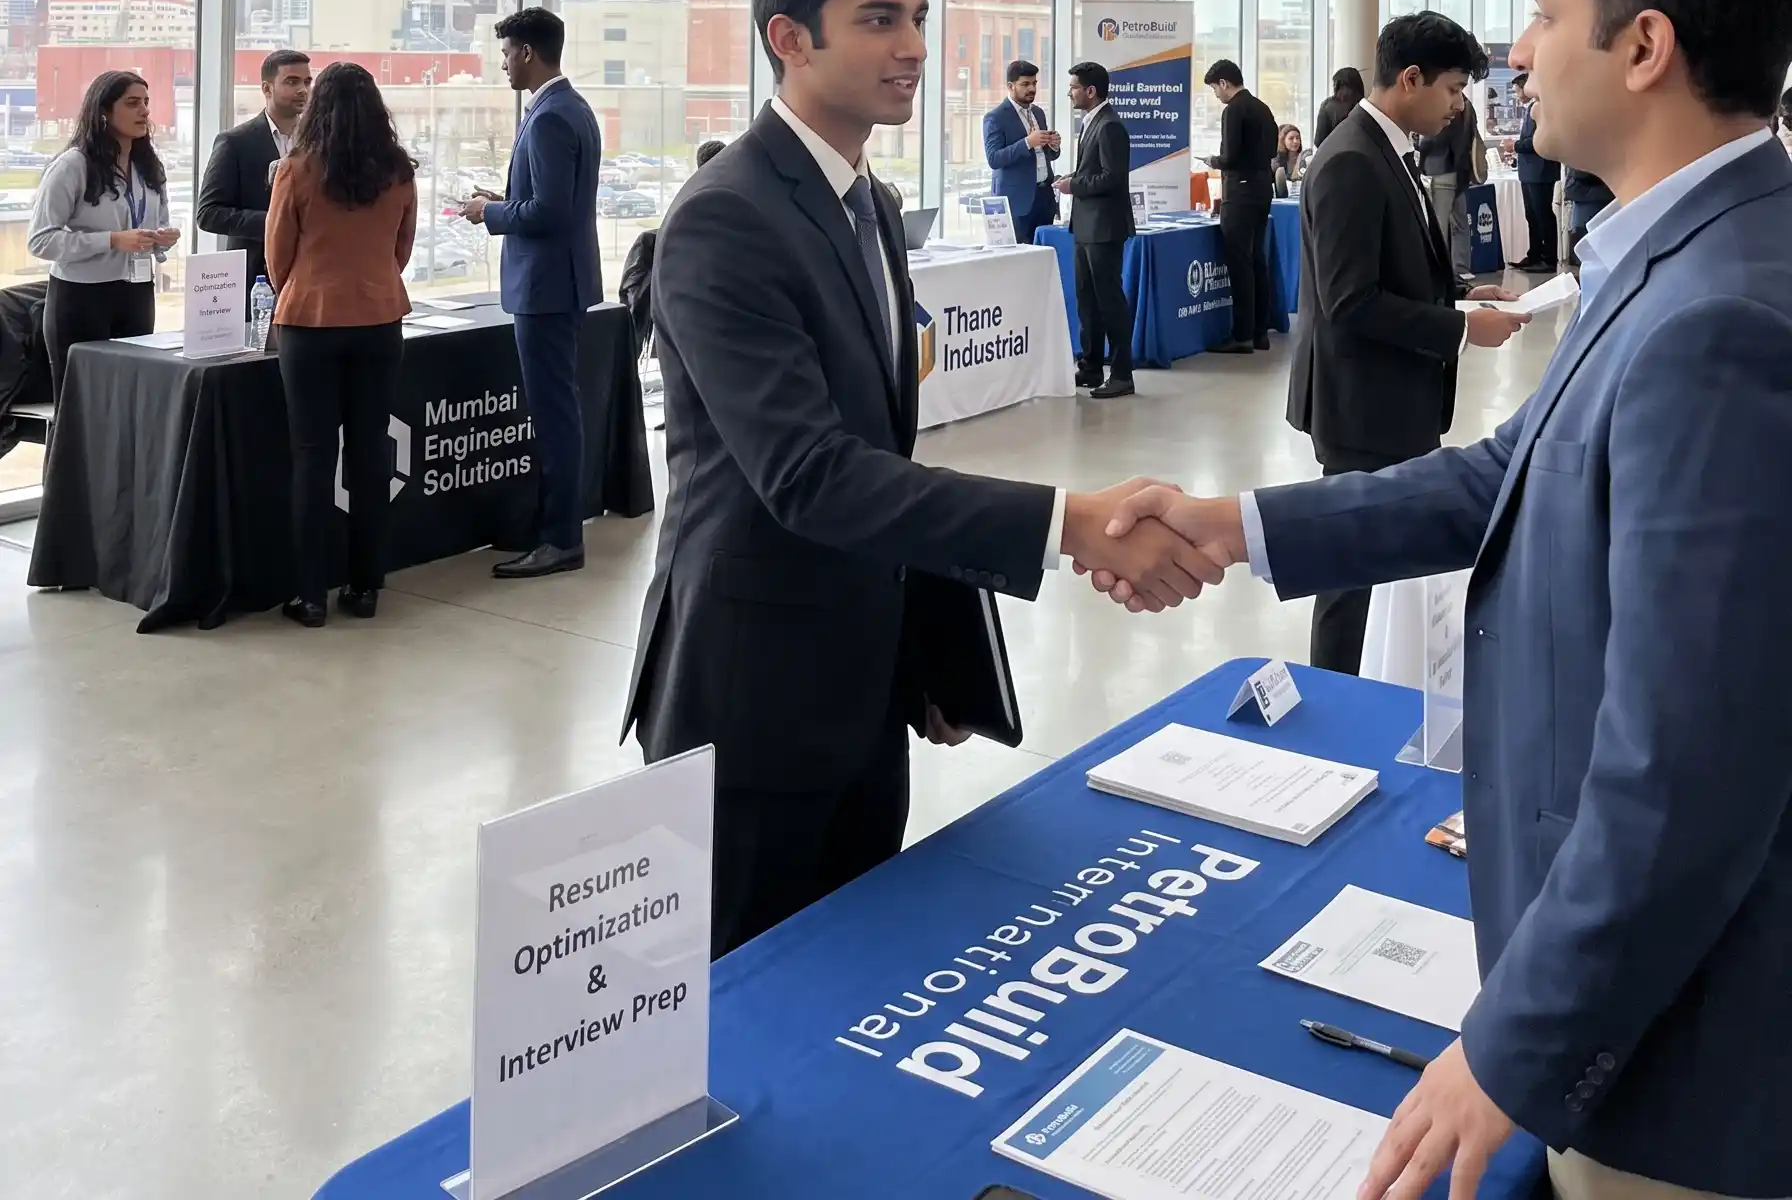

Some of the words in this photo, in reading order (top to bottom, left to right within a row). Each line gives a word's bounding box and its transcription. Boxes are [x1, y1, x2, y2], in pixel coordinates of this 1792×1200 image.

[1153, 109, 1179, 122] Prep
[199, 307, 231, 316] Interview
[943, 305, 1003, 336] Thane
[944, 326, 1029, 372] Industrial
[425, 385, 518, 427] Mumbai
[425, 416, 536, 461] Engineeri
[423, 455, 531, 496] Solutions
[549, 855, 650, 912] Resume
[514, 890, 680, 975] Optimization
[587, 964, 608, 995] &
[895, 843, 1261, 1099] PetroBuild
[499, 1007, 625, 1083] Interview
[632, 982, 687, 1023] Prep
